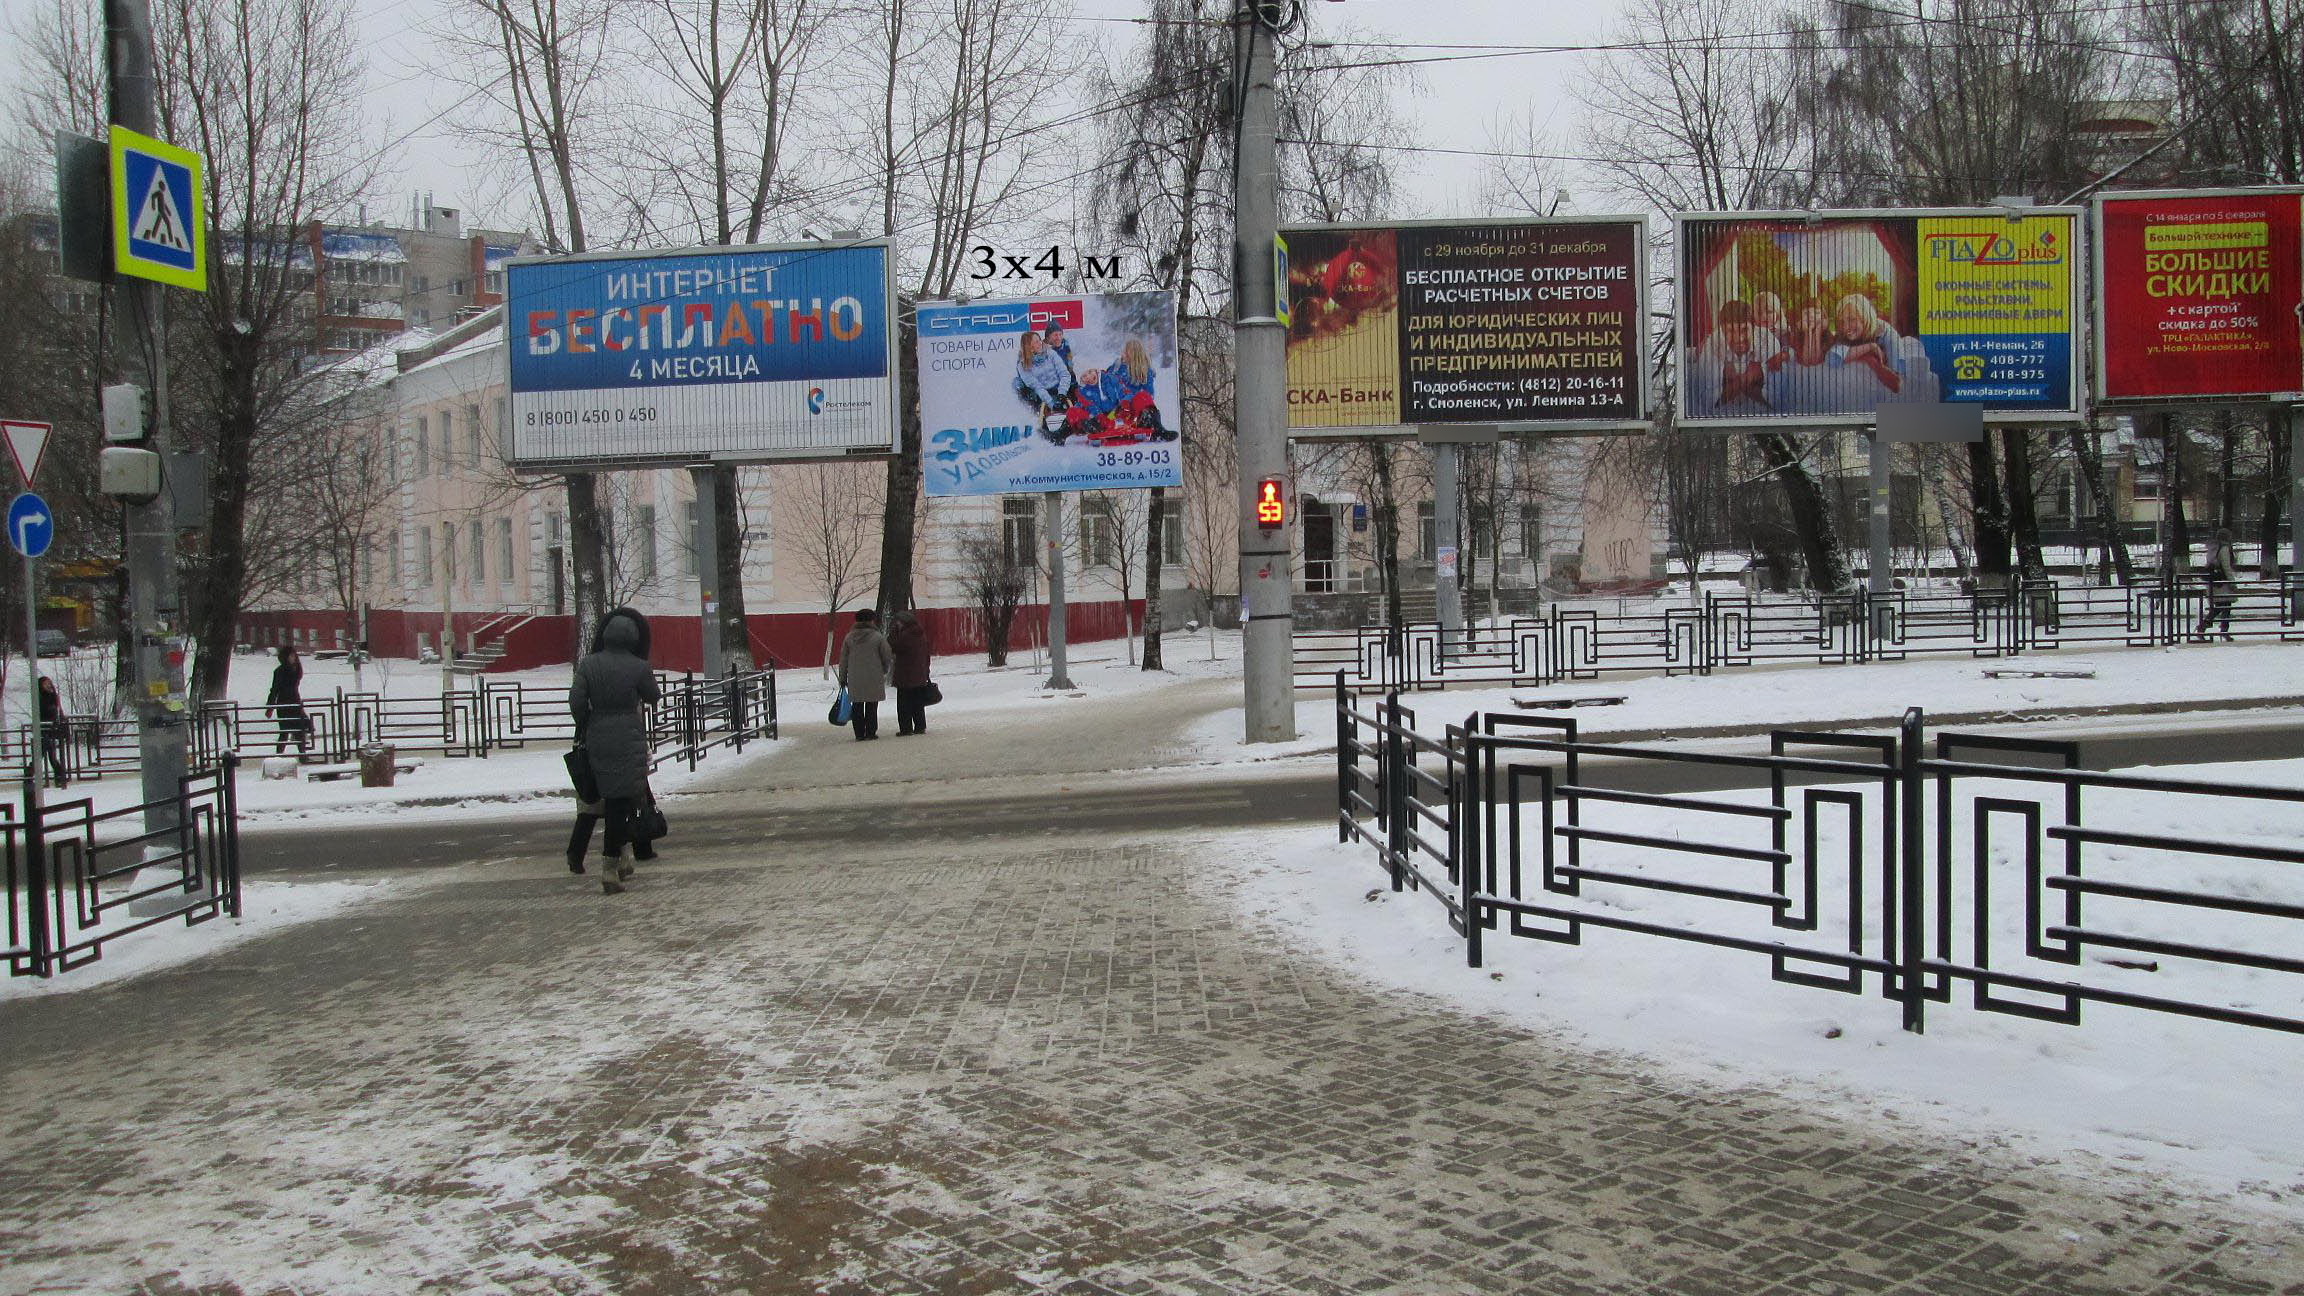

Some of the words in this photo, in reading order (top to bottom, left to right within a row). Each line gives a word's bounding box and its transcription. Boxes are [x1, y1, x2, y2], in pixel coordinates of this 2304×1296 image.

[2155, 214, 2165, 222] 14
[2167, 212, 2200, 223] января
[2202, 212, 2216, 220] по
[2217, 211, 2223, 220] 5
[2149, 231, 2201, 243] Большой
[2203, 232, 2252, 241] технике
[1424, 247, 1432, 257] с
[1435, 245, 1451, 257] 29
[1455, 243, 1505, 258] ноября
[1508, 244, 1526, 257] до
[1530, 242, 1544, 254] 31
[1550, 240, 1608, 255] декабря
[2017, 241, 2058, 261] plus
[2145, 249, 2269, 273] БОЛЬШИЕ
[606, 266, 779, 301] ИНТЕРНЕТ
[1406, 267, 1525, 285] БЕСПЛАТНОЕ
[1531, 265, 1628, 282] ОТКРЫТИЕ
[1425, 287, 1533, 303] РАСЧЕТНЫХ
[1537, 285, 1609, 301] СЧЕТОВ
[2146, 272, 2270, 299] СКИДКИ
[527, 295, 864, 356] БЕСПЛАТНО
[930, 310, 1069, 329] СТАДИОН
[1408, 315, 1443, 332] ДЛЯ
[1449, 312, 1581, 330] ЮРИДИЧЕСКИХ
[1586, 311, 1623, 328] ЛИЦ
[2158, 319, 2206, 331] скидка
[2208, 318, 2227, 331] до
[2230, 316, 2259, 328] 50%
[930, 339, 984, 354] ТОВАРЫ
[987, 337, 1015, 353] ДЛЯ
[1411, 335, 1423, 350] И
[1430, 330, 1623, 351] ИНДИВИДУАЛЬНЫХ
[629, 359, 644, 380] 4
[651, 353, 761, 380] МЕСЯЦА
[931, 357, 987, 372] СПОРТА
[1410, 349, 1623, 374] ПРЕДПРИНИМАТЕЛЕЙ
[1990, 355, 2045, 365] 408-777
[1990, 370, 2045, 379] 418-975
[1413, 379, 1515, 396] Подробности:
[1519, 378, 1562, 393] (4812)
[1566, 376, 1625, 390] 20-16-11
[1286, 387, 1394, 405] СКА-Банк
[1413, 402, 1424, 410] г.
[1428, 396, 1502, 410] Смоленск,
[1506, 398, 1528, 410] ул.
[1532, 395, 1585, 407] Ленина
[1590, 393, 1624, 406] 13-А
[527, 412, 536, 426] 8
[540, 409, 578, 427] (800)
[582, 409, 610, 425] 450
[615, 408, 624, 423] 0
[628, 407, 657, 422] 450
[1096, 450, 1171, 467] 38-89-03
[1150, 468, 1172, 480] 15/2
[1258, 502, 1282, 522] 53
